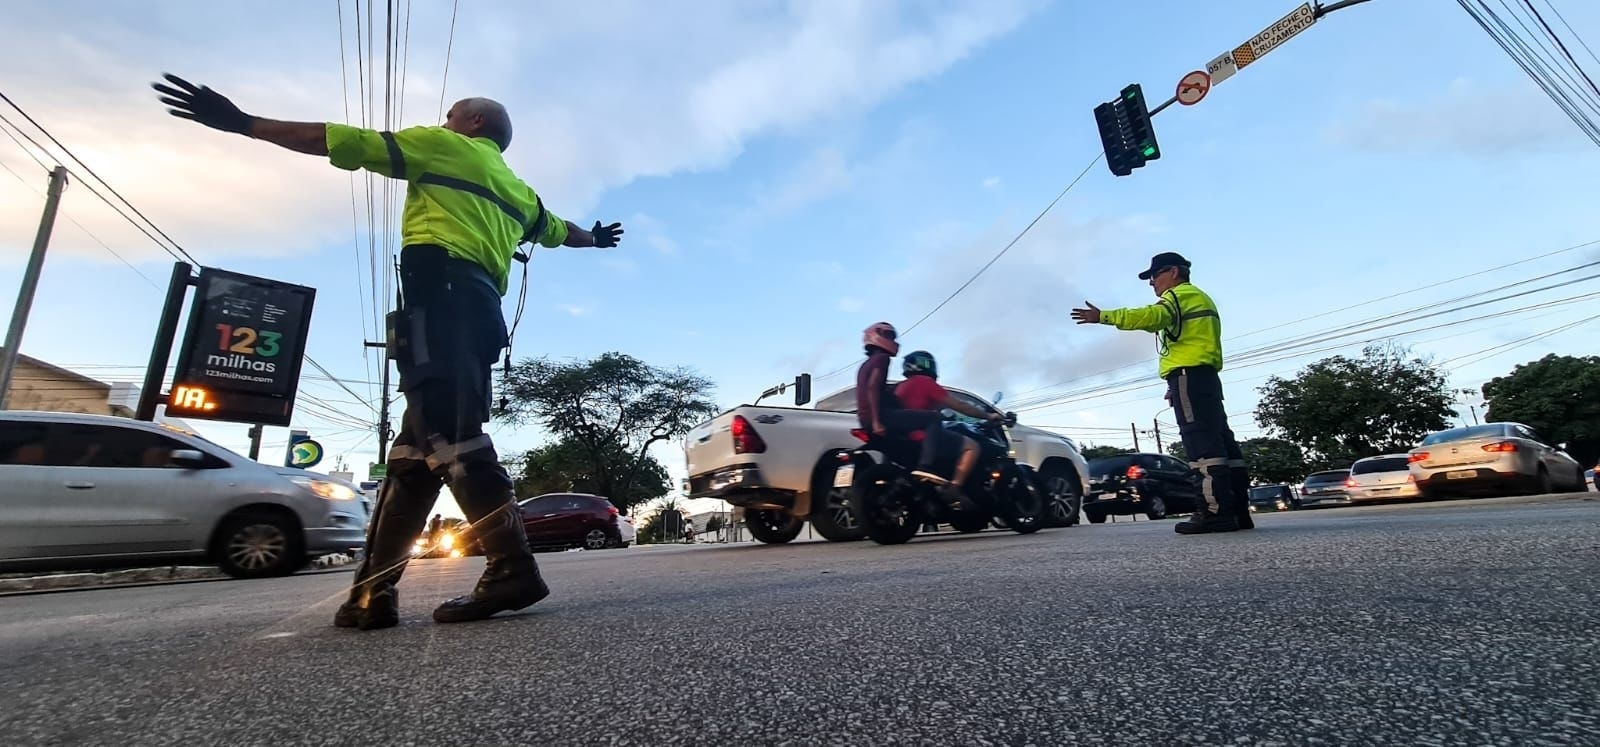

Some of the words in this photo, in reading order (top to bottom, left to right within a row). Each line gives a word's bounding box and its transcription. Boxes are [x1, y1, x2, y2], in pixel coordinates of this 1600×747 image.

[1271, 12, 1300, 35] FECHE
[1301, 7, 1308, 16] O
[1254, 15, 1312, 55] CRUZAMENTO
[1208, 60, 1223, 74] 057
[216, 323, 282, 357] 123
[207, 354, 276, 373] milhas
[206, 369, 273, 383] 123milhas.com
